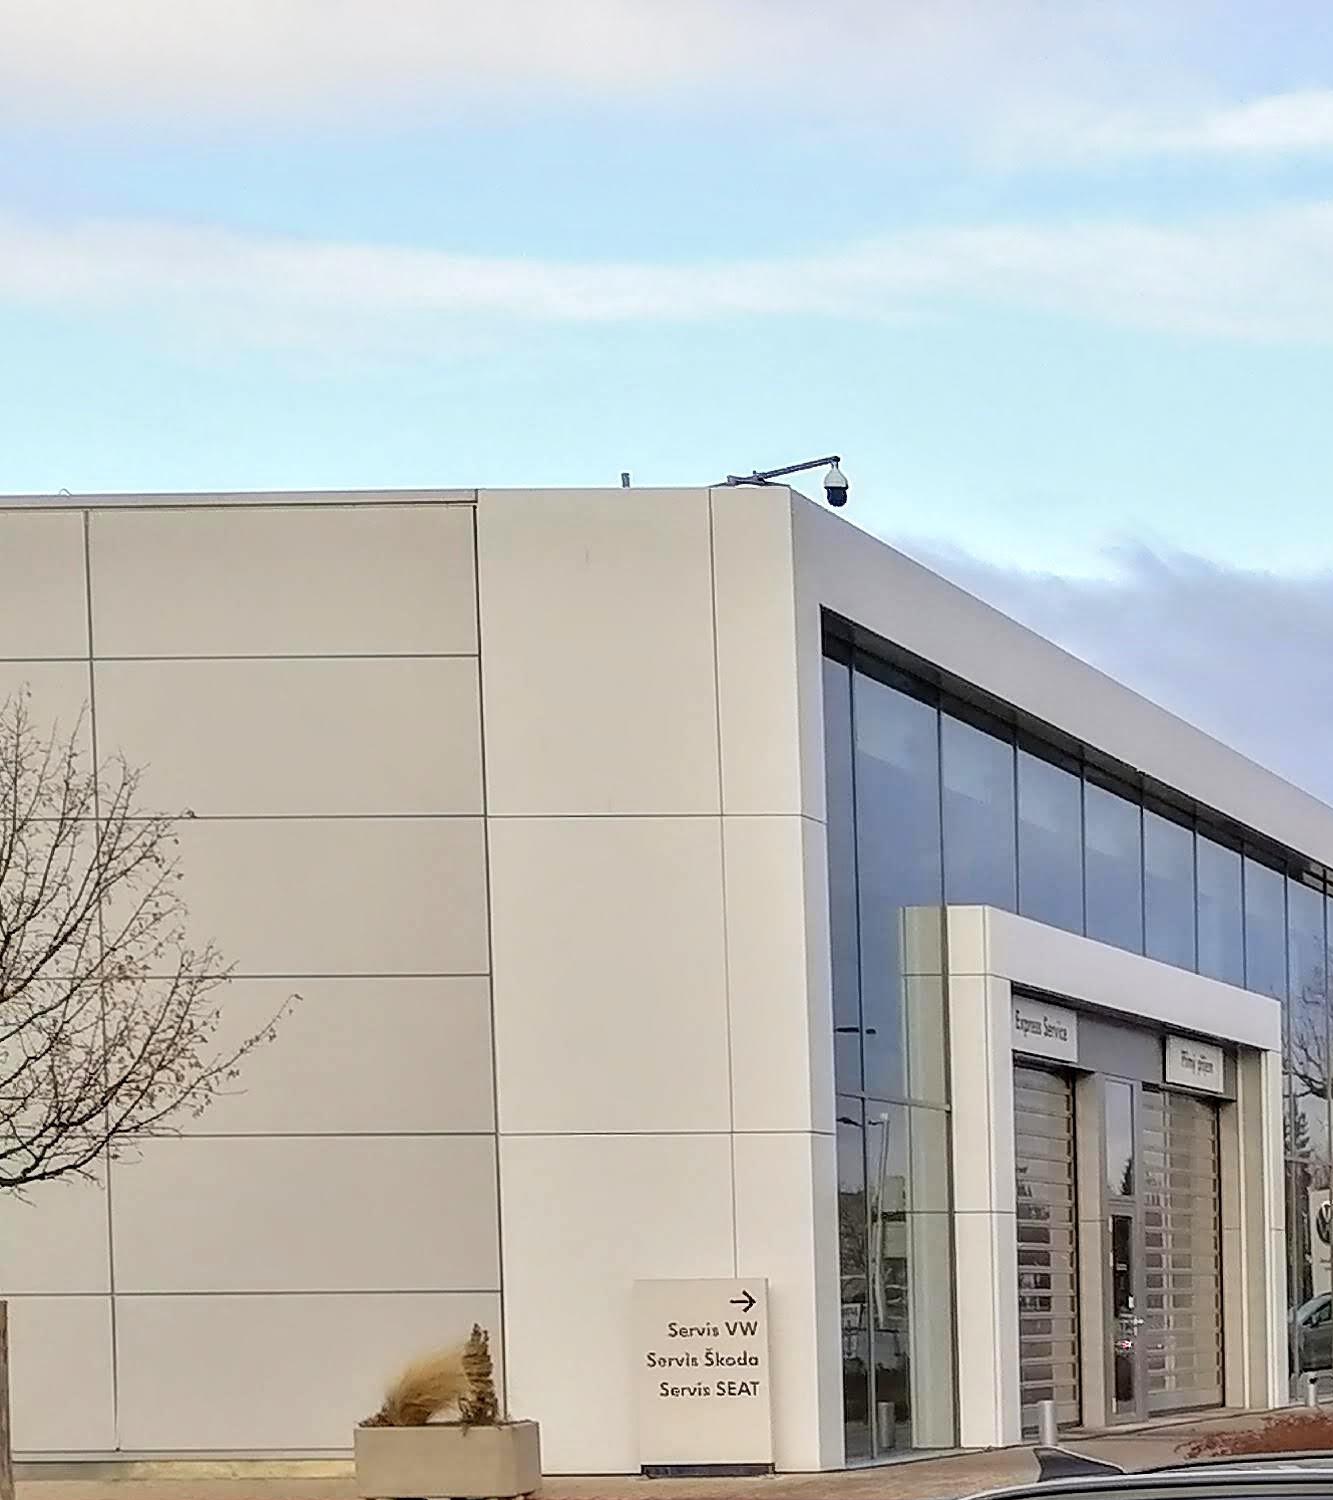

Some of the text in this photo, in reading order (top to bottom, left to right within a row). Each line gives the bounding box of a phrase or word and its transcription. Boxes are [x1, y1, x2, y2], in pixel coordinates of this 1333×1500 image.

[667, 1320, 758, 1338] Servis VW
[646, 1346, 760, 1368] Servis Škoda
[659, 1380, 761, 1398] Servis SEAT
